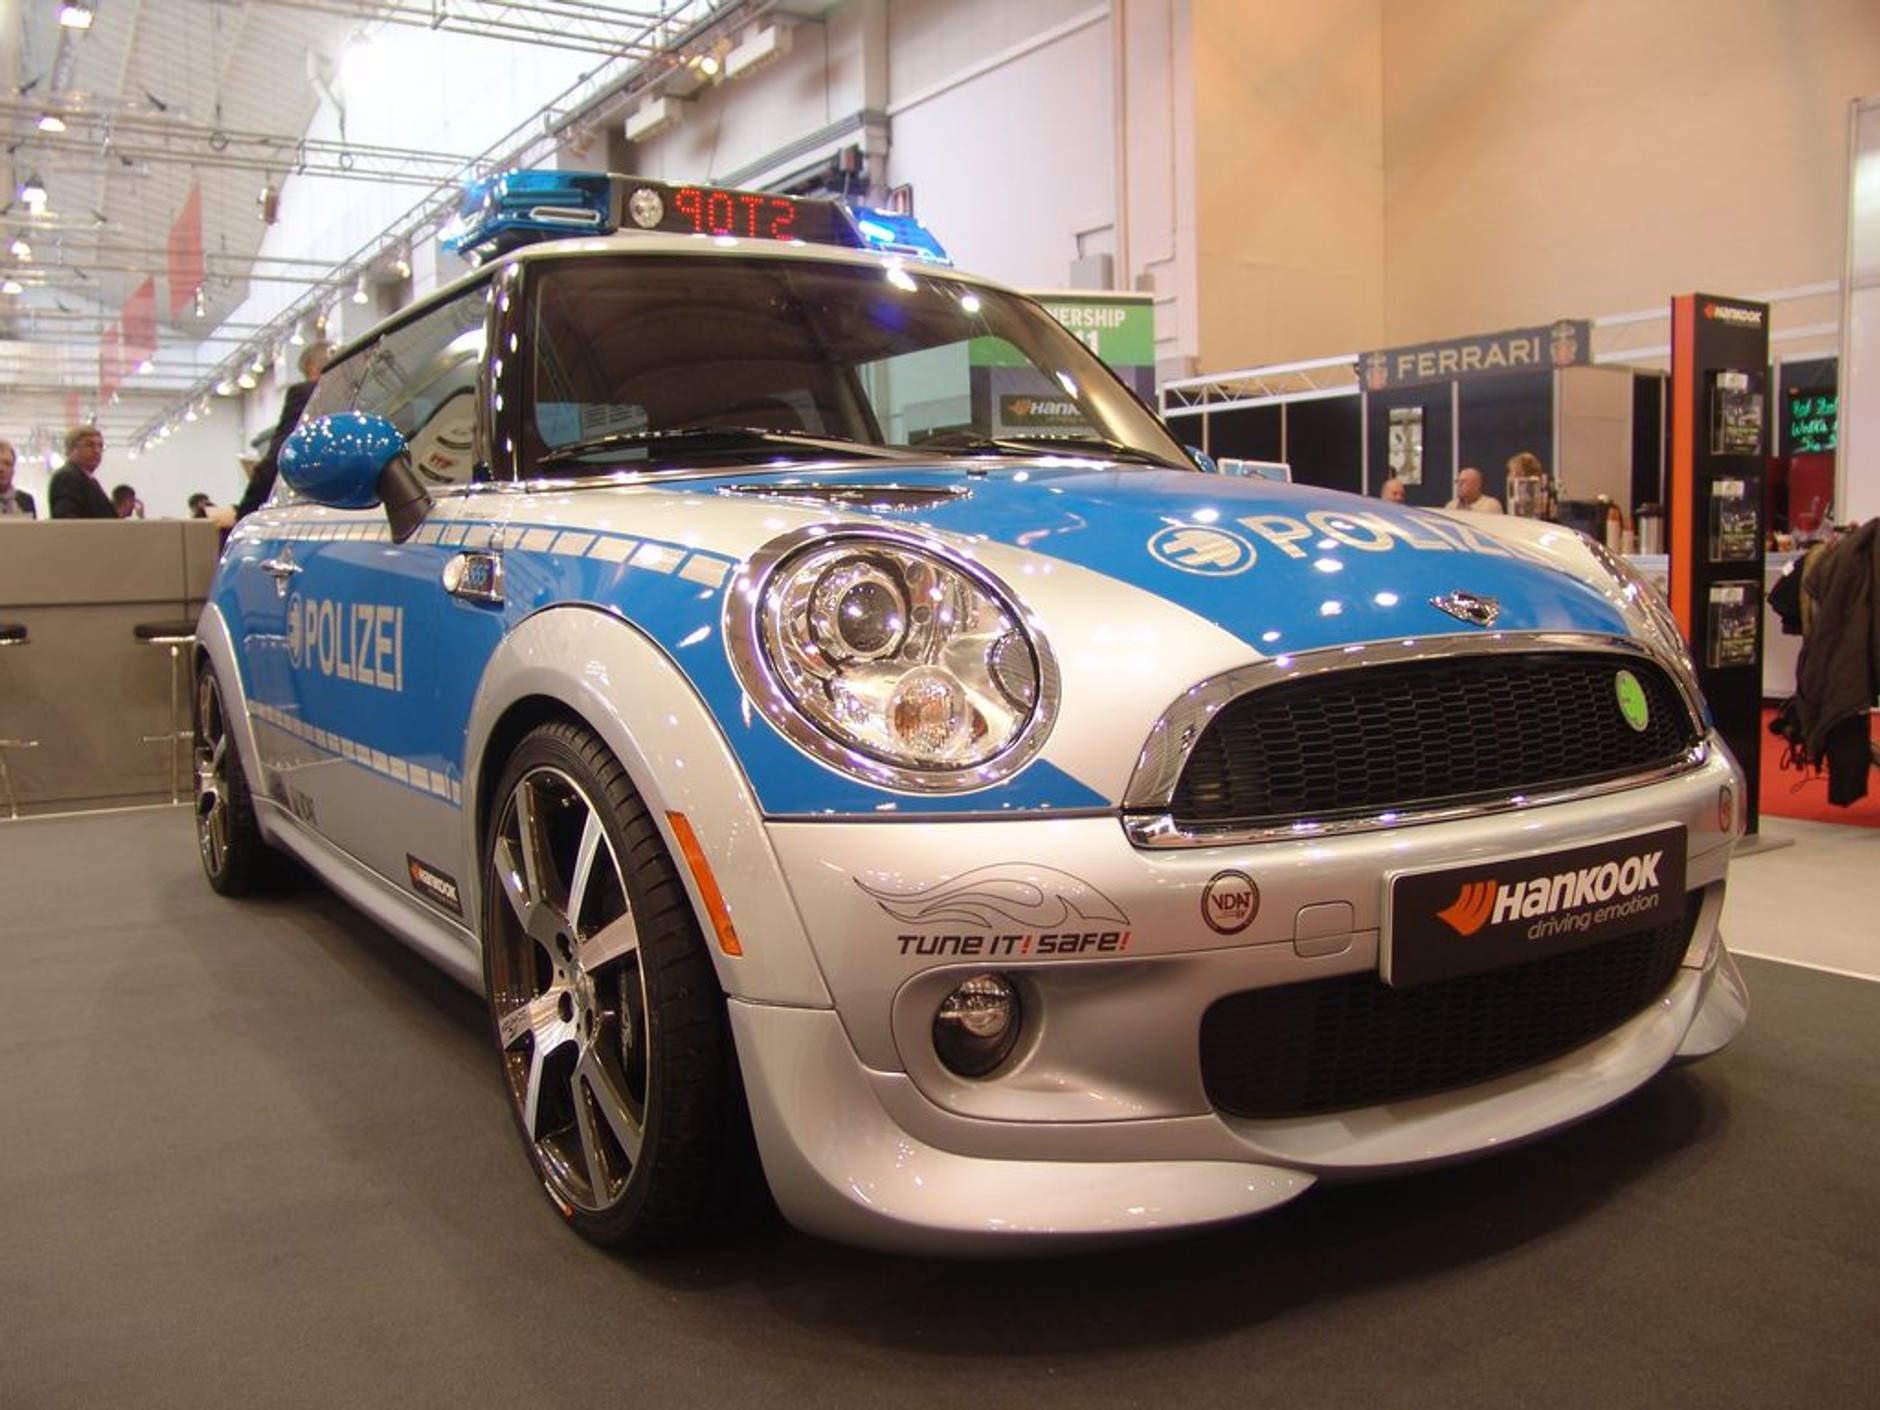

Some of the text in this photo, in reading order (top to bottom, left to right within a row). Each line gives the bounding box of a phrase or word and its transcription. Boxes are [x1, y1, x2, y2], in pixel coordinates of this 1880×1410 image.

[1397, 336, 1541, 379] FERRARI
[1236, 510, 1540, 566] POLIZ
[304, 598, 404, 692] POLIZEI
[1527, 893, 1660, 941] driving emotion
